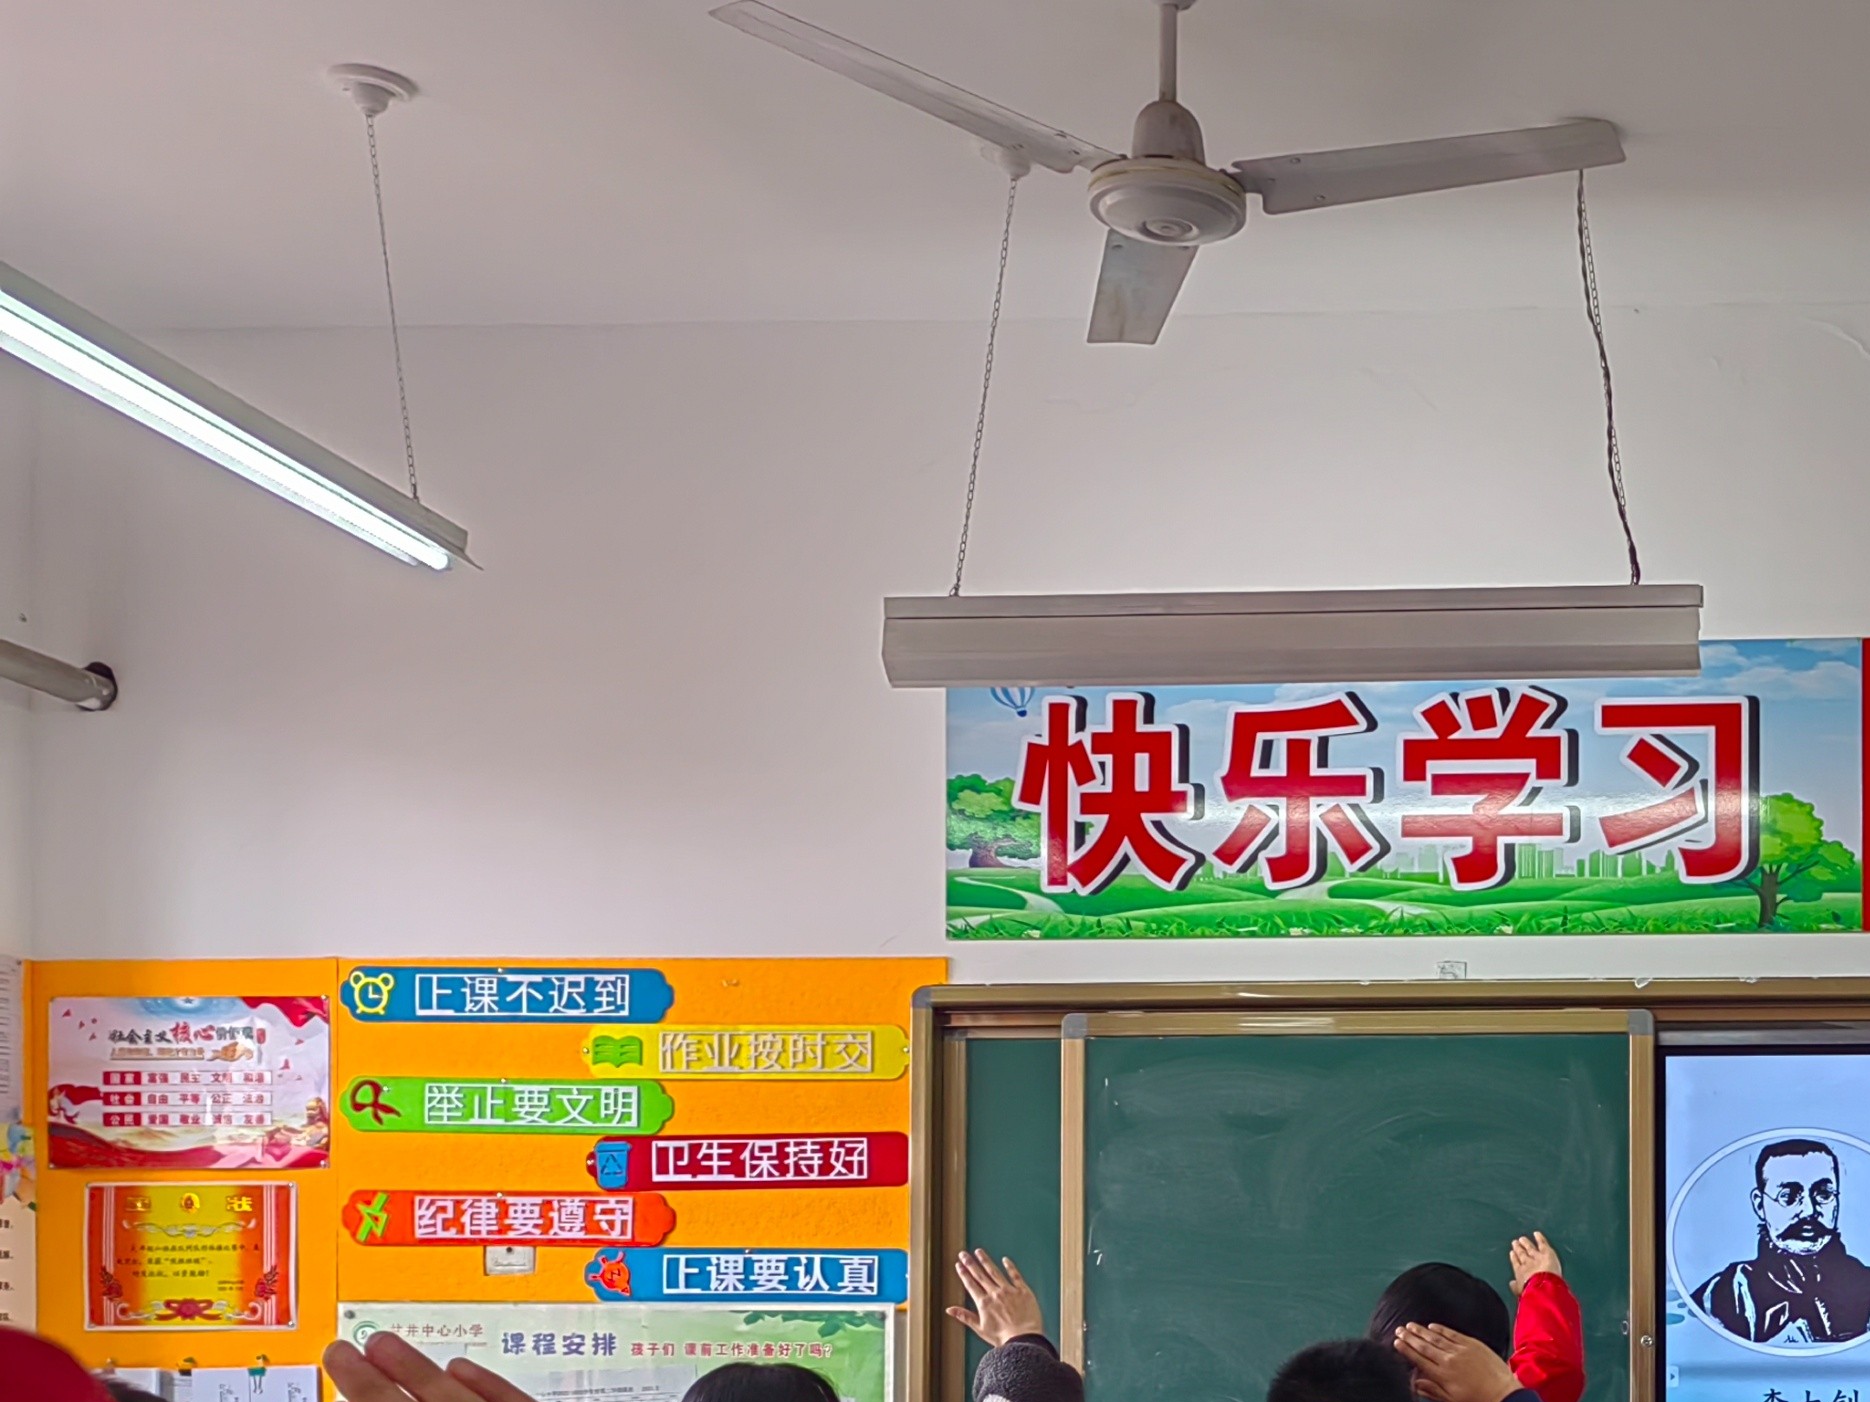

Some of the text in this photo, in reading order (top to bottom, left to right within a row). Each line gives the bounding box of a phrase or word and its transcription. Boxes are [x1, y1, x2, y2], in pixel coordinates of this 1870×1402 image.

[1013, 685, 1760, 895] 快乐学习
[416, 974, 630, 1016] 上课不迟到
[659, 1030, 873, 1072] 作业按时交
[425, 1083, 639, 1127] 举止要文明
[653, 1138, 868, 1181] 卫生保持好
[415, 1197, 632, 1240] 纪律要遵守
[663, 1255, 878, 1295] 上课要认真
[501, 1331, 618, 1356] 课程安排
[631, 1343, 676, 1357] 孩子们
